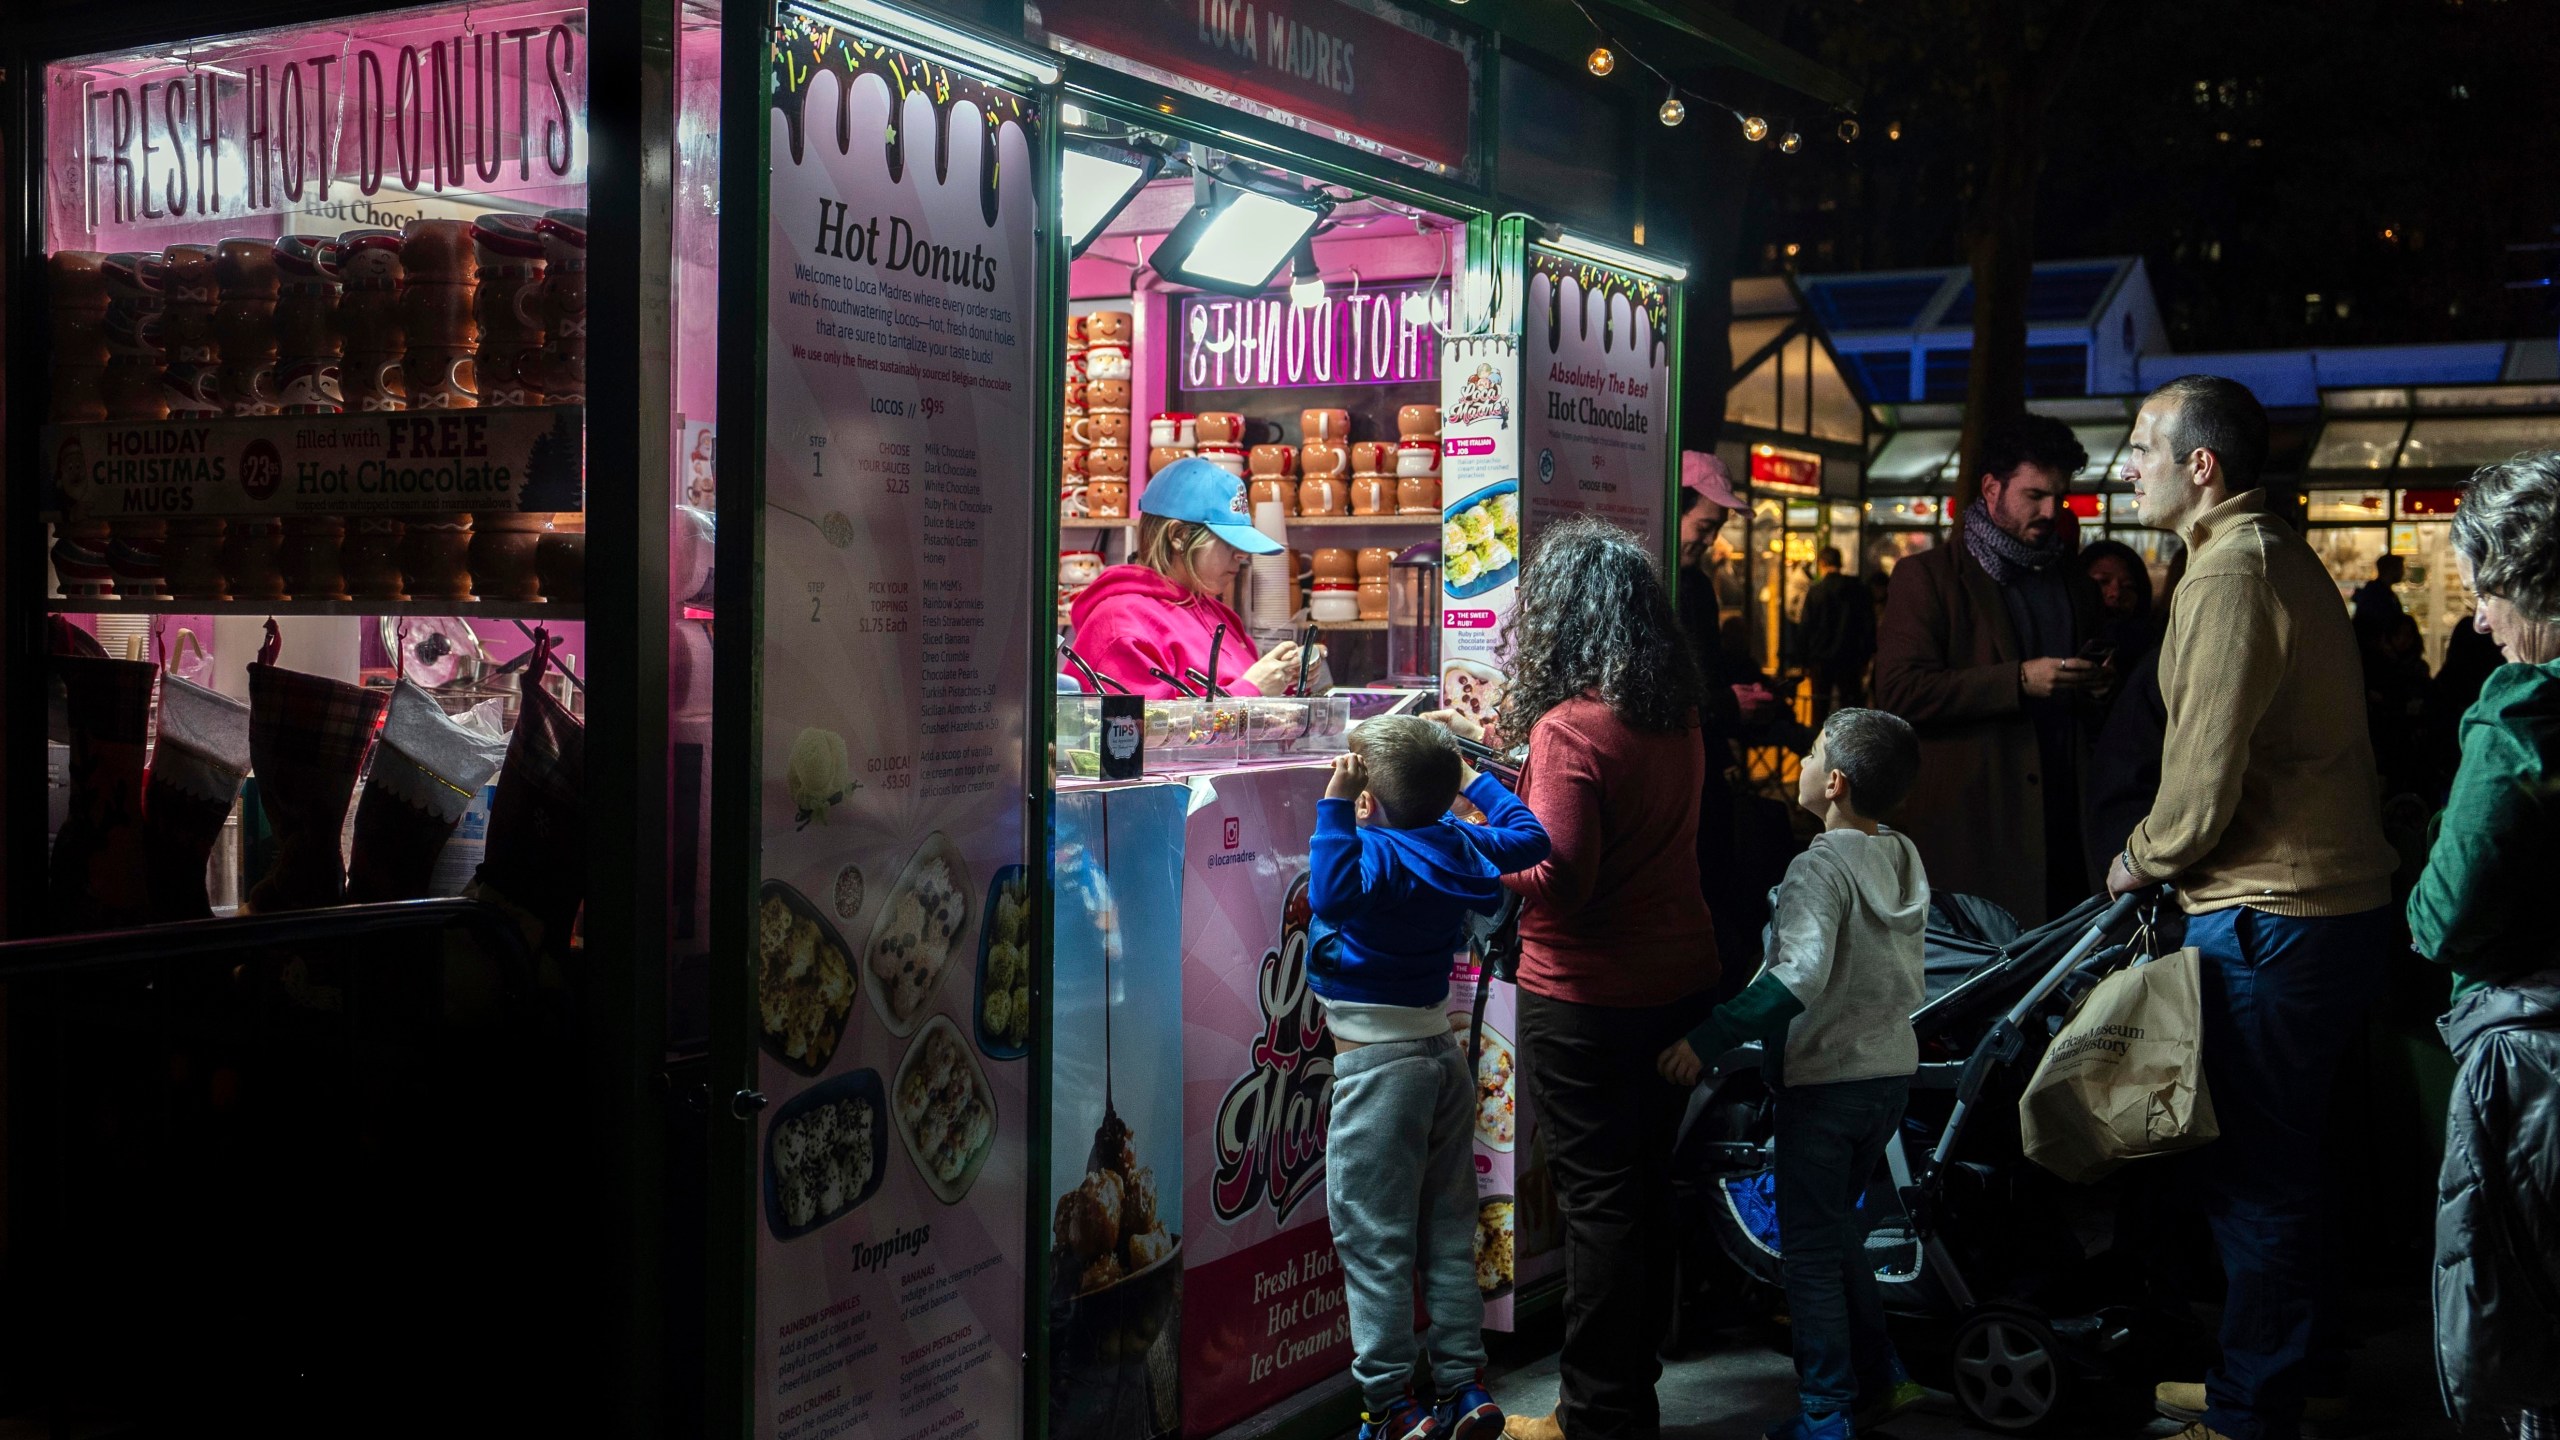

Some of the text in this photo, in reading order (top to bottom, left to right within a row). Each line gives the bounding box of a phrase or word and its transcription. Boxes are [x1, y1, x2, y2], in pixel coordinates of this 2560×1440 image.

[1198, 0, 1355, 94] LOCA MADRES
[87, 24, 573, 226] FRESH HOT DONUTS
[304, 191, 346, 222] Hot
[815, 197, 997, 292] Hot Donuts
[795, 263, 1012, 323] Welcome to Loca Madres where every order starts
[789, 289, 811, 307] with
[812, 292, 818, 308] 6
[821, 297, 893, 327] mouthwatering
[947, 317, 967, 337] fresh
[969, 322, 992, 342] donut
[994, 326, 1016, 346] holes
[816, 319, 994, 364] that are sure to tantalize your taste buds!
[793, 344, 1012, 392] We use only the finest sustainably sourced Belgian chocolate
[1549, 362, 1648, 398] Absolutely The Best
[1459, 383, 1502, 404] Loca
[871, 396, 904, 416] LOCOS
[1548, 391, 1648, 434] Hot Chocolate
[107, 428, 210, 457] HOLIDAY
[296, 416, 487, 459] filled with FREE
[809, 436, 826, 447] STEP
[879, 442, 910, 457] CHOOSE
[925, 443, 976, 460] Milk Chocolate
[1447, 442, 1454, 454] 1
[92, 455, 226, 485] CHRISTMAS
[812, 451, 822, 477] 1
[858, 459, 910, 475] YOUR SAUCES
[925, 461, 977, 478] Dark Chocolate
[296, 459, 510, 494] Hot Chocolate
[886, 479, 910, 494] $2.25
[924, 479, 981, 496] White Chocolate
[123, 486, 194, 513] MUGS
[295, 500, 326, 511] topped
[327, 499, 348, 509] with
[350, 499, 390, 512] whipped
[391, 500, 421, 509] cream
[924, 497, 993, 514] Ruby Pink Chocolate
[924, 515, 975, 531] Dulce de Leche
[923, 533, 978, 548] Pistachio Cream
[923, 552, 946, 565] Honey
[807, 582, 825, 592] STEP
[869, 582, 908, 594] PICK YOUR
[923, 579, 938, 592] Mini
[811, 596, 821, 622] 2
[871, 600, 908, 613] TOPPINGS
[923, 598, 984, 612] Rainbow Sprinkles
[859, 618, 908, 633] $1.75 Each
[922, 615, 984, 629] Fresh Strawberries
[1447, 613, 1455, 625] 2
[922, 632, 970, 645] Sliced Banana
[922, 651, 969, 663] Oreo Crumble
[922, 668, 978, 681] Chocolate Pearls
[921, 686, 947, 699] Turkish
[948, 686, 981, 698] Pistachios
[921, 704, 946, 717] Sicilian
[947, 702, 977, 715] Almonds
[920, 722, 949, 735] Crushed
[950, 720, 984, 733] Hazelnuts
[1113, 723, 1134, 737] TIPS
[867, 756, 910, 773] GO LOCA!
[881, 774, 910, 790] +$3.50
[1208, 851, 1256, 869] @locamadres
[852, 1224, 930, 1273] Toppings
[901, 1264, 936, 1287] BANANAS
[1253, 1258, 1298, 1304] Fresh
[1302, 1246, 1336, 1283] Hot
[779, 1294, 860, 1338] RAINBOW SPRINKLES
[1267, 1298, 1299, 1336] Hot
[900, 1325, 972, 1366] TURKISH PISTACHIOS
[1248, 1353, 1273, 1384] Ice
[1276, 1328, 1332, 1369] Cream
[778, 1385, 841, 1425] OREO CRUMBLE
